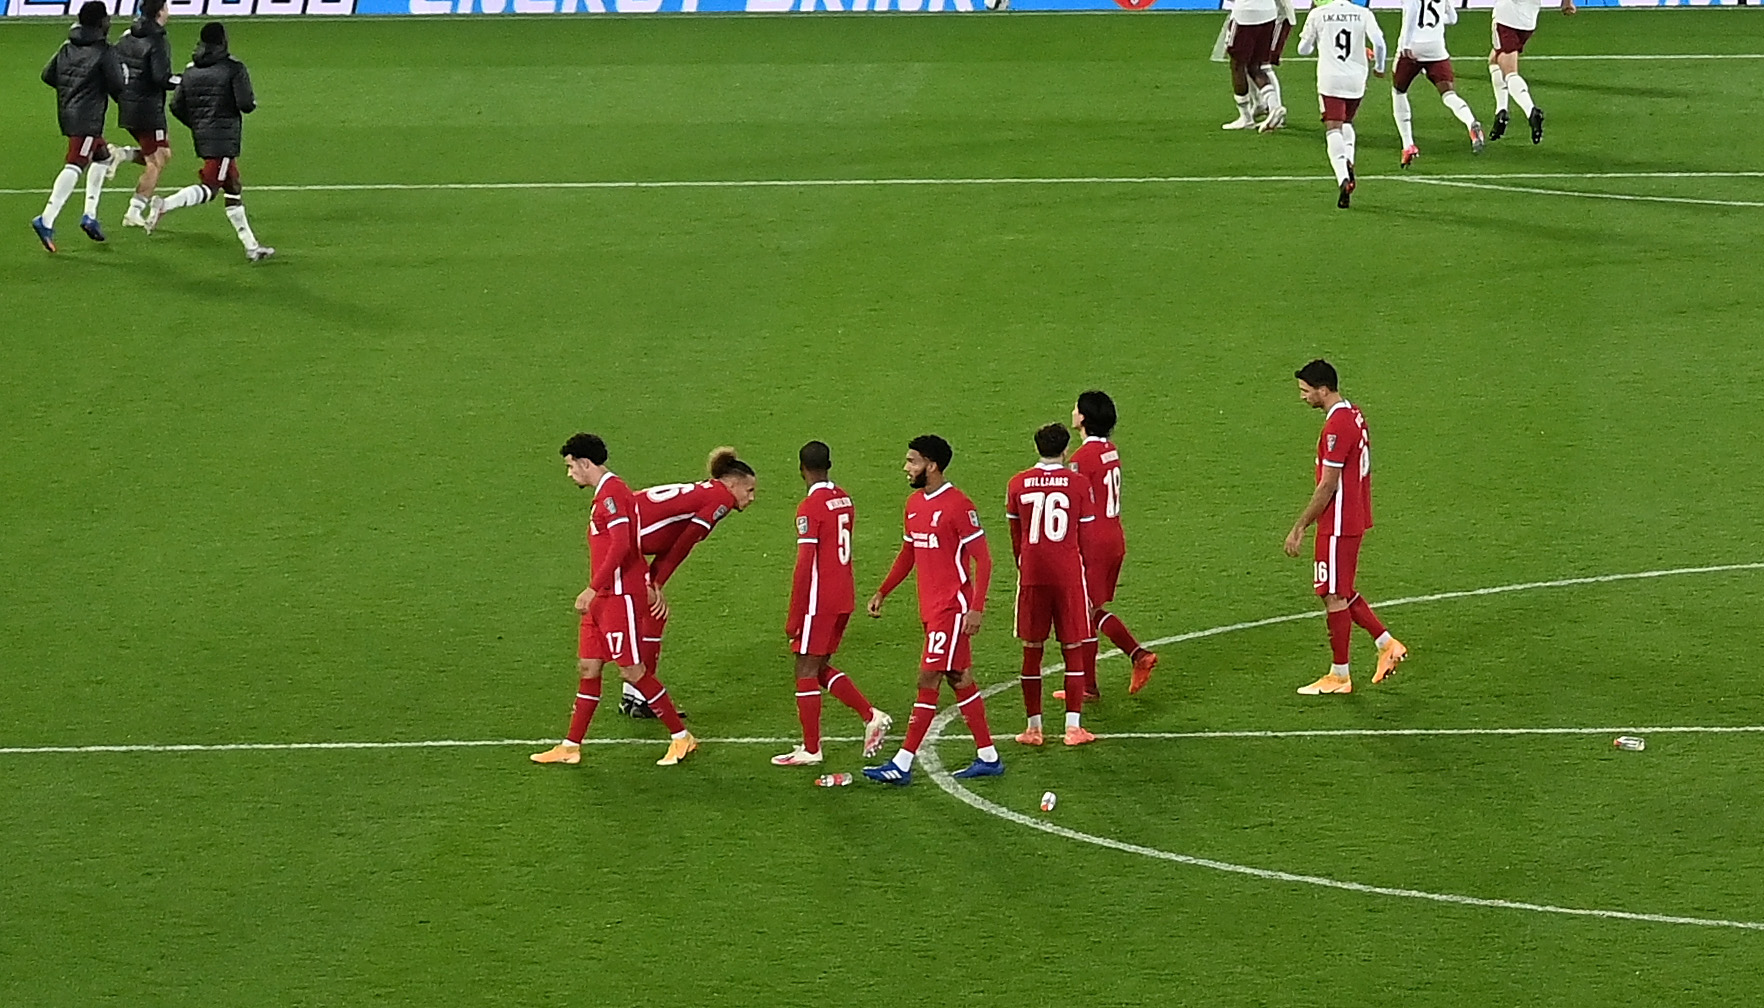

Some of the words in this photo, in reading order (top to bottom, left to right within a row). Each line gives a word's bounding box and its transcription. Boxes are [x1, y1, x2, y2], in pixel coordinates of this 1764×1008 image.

[1335, 28, 1352, 62] 9
[1020, 491, 1071, 545] 76
[837, 513, 851, 566] 5
[1313, 561, 1329, 583] 16
[606, 631, 624, 654] 17
[927, 631, 947, 655] 12
